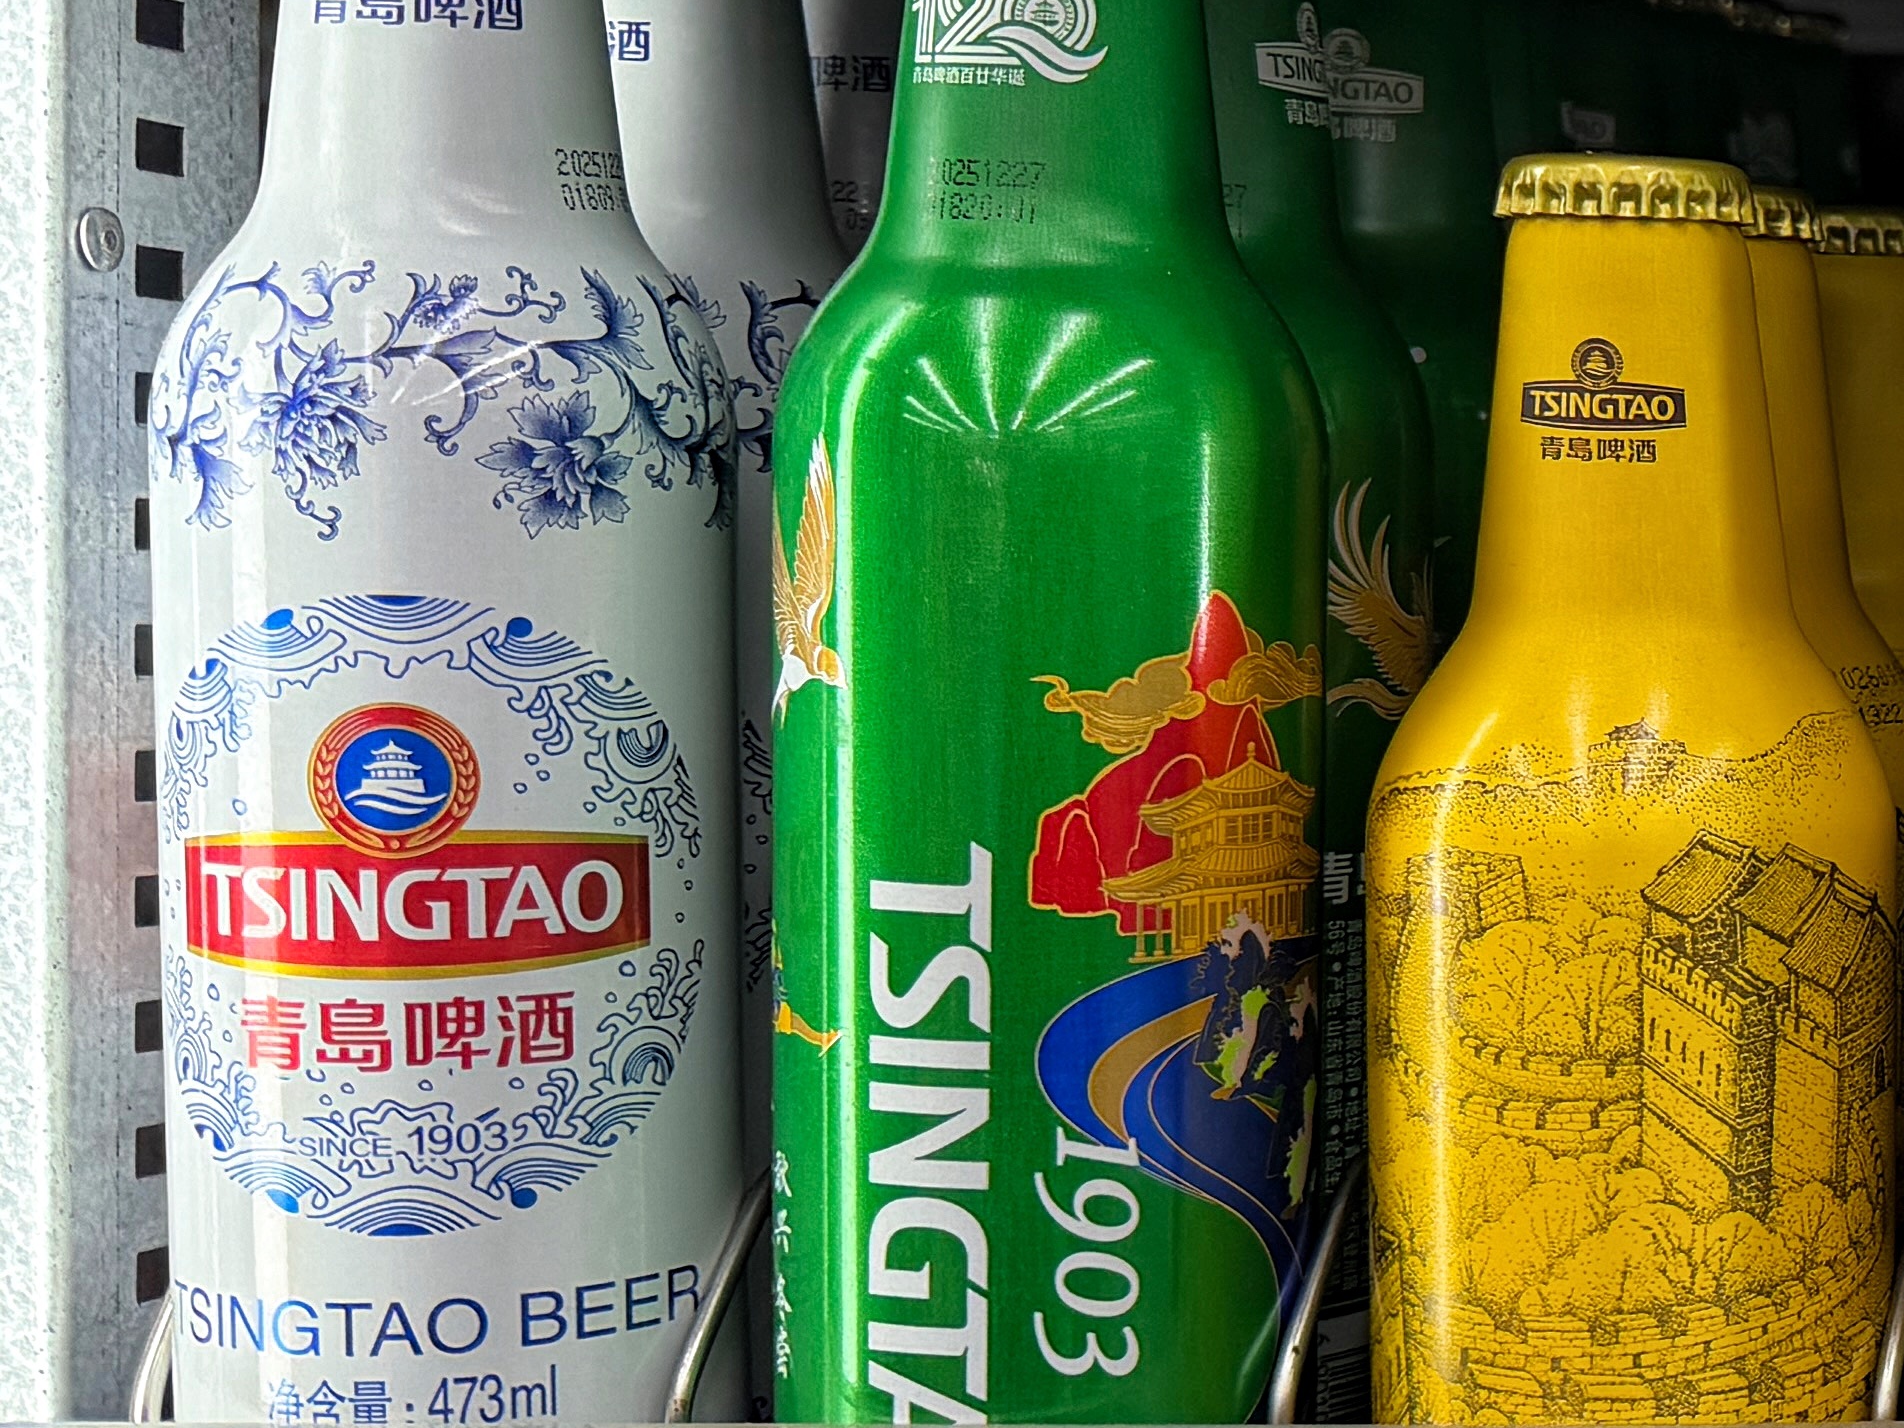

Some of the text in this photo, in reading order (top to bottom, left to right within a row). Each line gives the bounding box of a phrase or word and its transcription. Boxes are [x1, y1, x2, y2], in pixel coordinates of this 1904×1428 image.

[1530, 389, 1677, 424] TSINGTAO
[202, 860, 625, 943] TSINGTAO
[297, 1121, 512, 1161] SINCE 1903
[1032, 1124, 1142, 1378] 1903
[173, 1264, 702, 1358] TSINGTAO BEER
